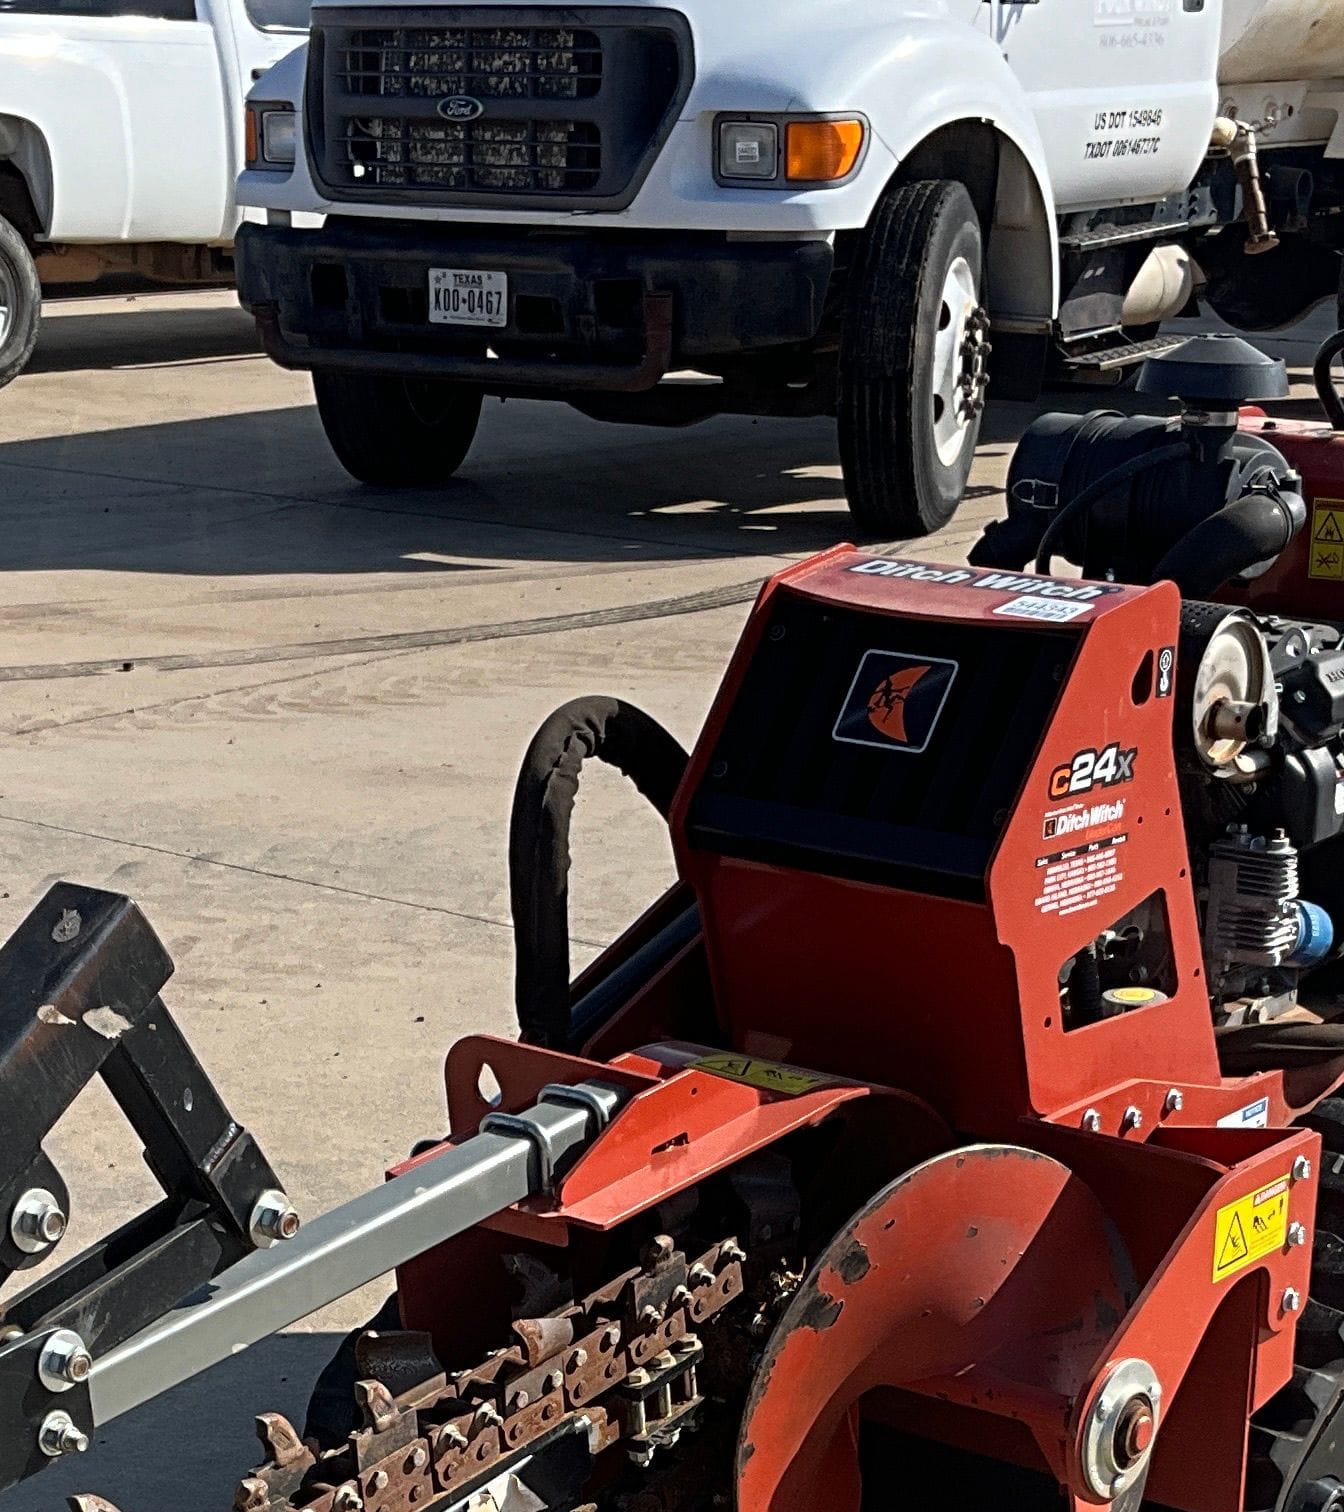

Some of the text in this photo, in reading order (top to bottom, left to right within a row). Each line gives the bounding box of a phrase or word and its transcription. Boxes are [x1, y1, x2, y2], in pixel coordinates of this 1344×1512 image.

[1095, 112, 1106, 130] US
[1109, 111, 1126, 129] DOT
[452, 273, 483, 285] TEXAS
[849, 559, 1104, 600] Ditch Witch
[1056, 809, 1090, 835] Ditch
[1090, 800, 1123, 826] Witch
